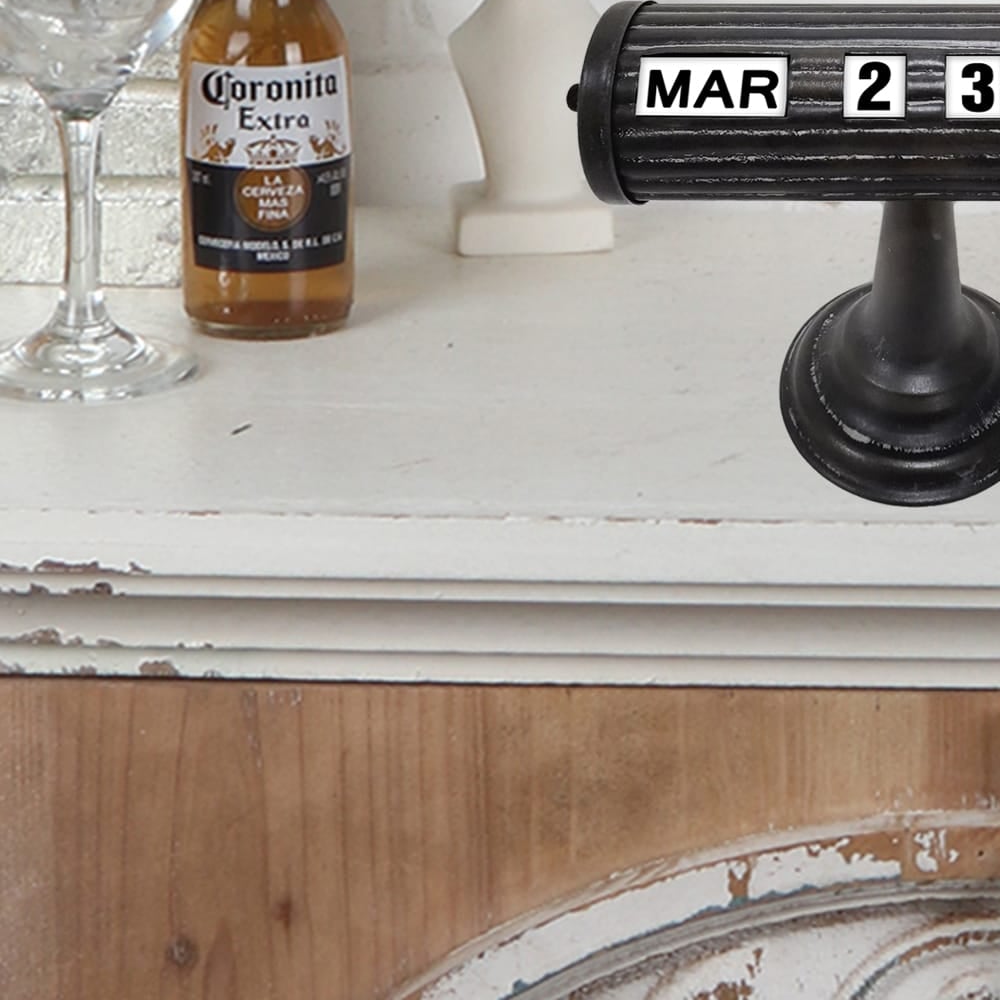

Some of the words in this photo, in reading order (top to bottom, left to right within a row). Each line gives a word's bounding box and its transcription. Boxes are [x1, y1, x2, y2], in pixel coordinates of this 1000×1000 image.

[202, 69, 338, 110] Coronita
[646, 69, 779, 109] MAR
[857, 61, 891, 111] 2
[961, 62, 994, 112] 3
[240, 106, 310, 131] Extra
[263, 175, 283, 186] LA
[242, 184, 304, 198] CERVEZA
[257, 208, 290, 221] FINA
